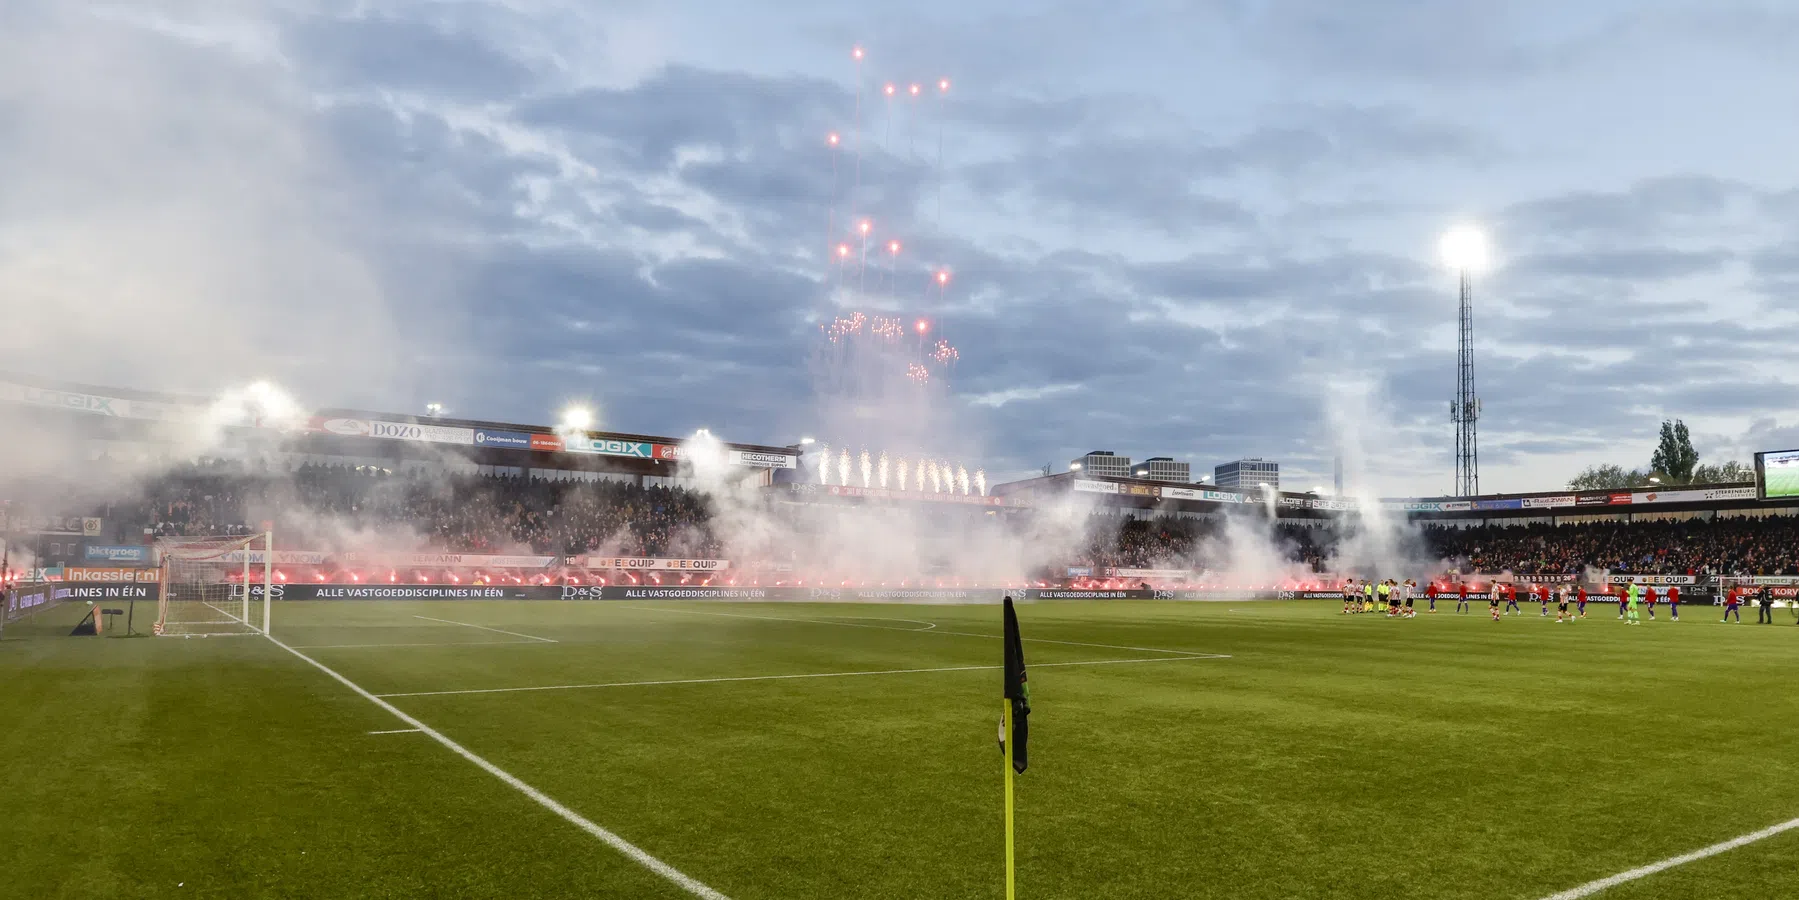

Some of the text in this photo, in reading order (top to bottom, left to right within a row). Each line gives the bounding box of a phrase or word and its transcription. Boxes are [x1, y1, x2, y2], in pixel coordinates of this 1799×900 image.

[373, 423, 422, 439] DOZO
[576, 440, 646, 458] LOGIX
[742, 453, 786, 463] HECOTHERM
[790, 483, 816, 493] D&S
[1715, 488, 1756, 496] STERRENBURG
[1207, 491, 1239, 503] LOGIX
[1403, 502, 1441, 511] LOGIX
[607, 559, 655, 568] BEEQUIP
[673, 560, 717, 568] BEEQUIP
[69, 568, 159, 581] Inkassier.nl
[68, 588, 102, 597] LINES
[106, 588, 118, 597] IN
[228, 584, 286, 597] D&S
[316, 586, 504, 597] ALLE VASTGOEDDISCIPLINES IN ÉÉN
[562, 586, 603, 597] D&S
[626, 590, 646, 598] ALLE
[648, 590, 738, 598] VASTGOEDDISCIPLINES
[750, 588, 765, 598] ÉÉN
[1001, 588, 1027, 598] D&S
[1154, 590, 1174, 598] D&S
